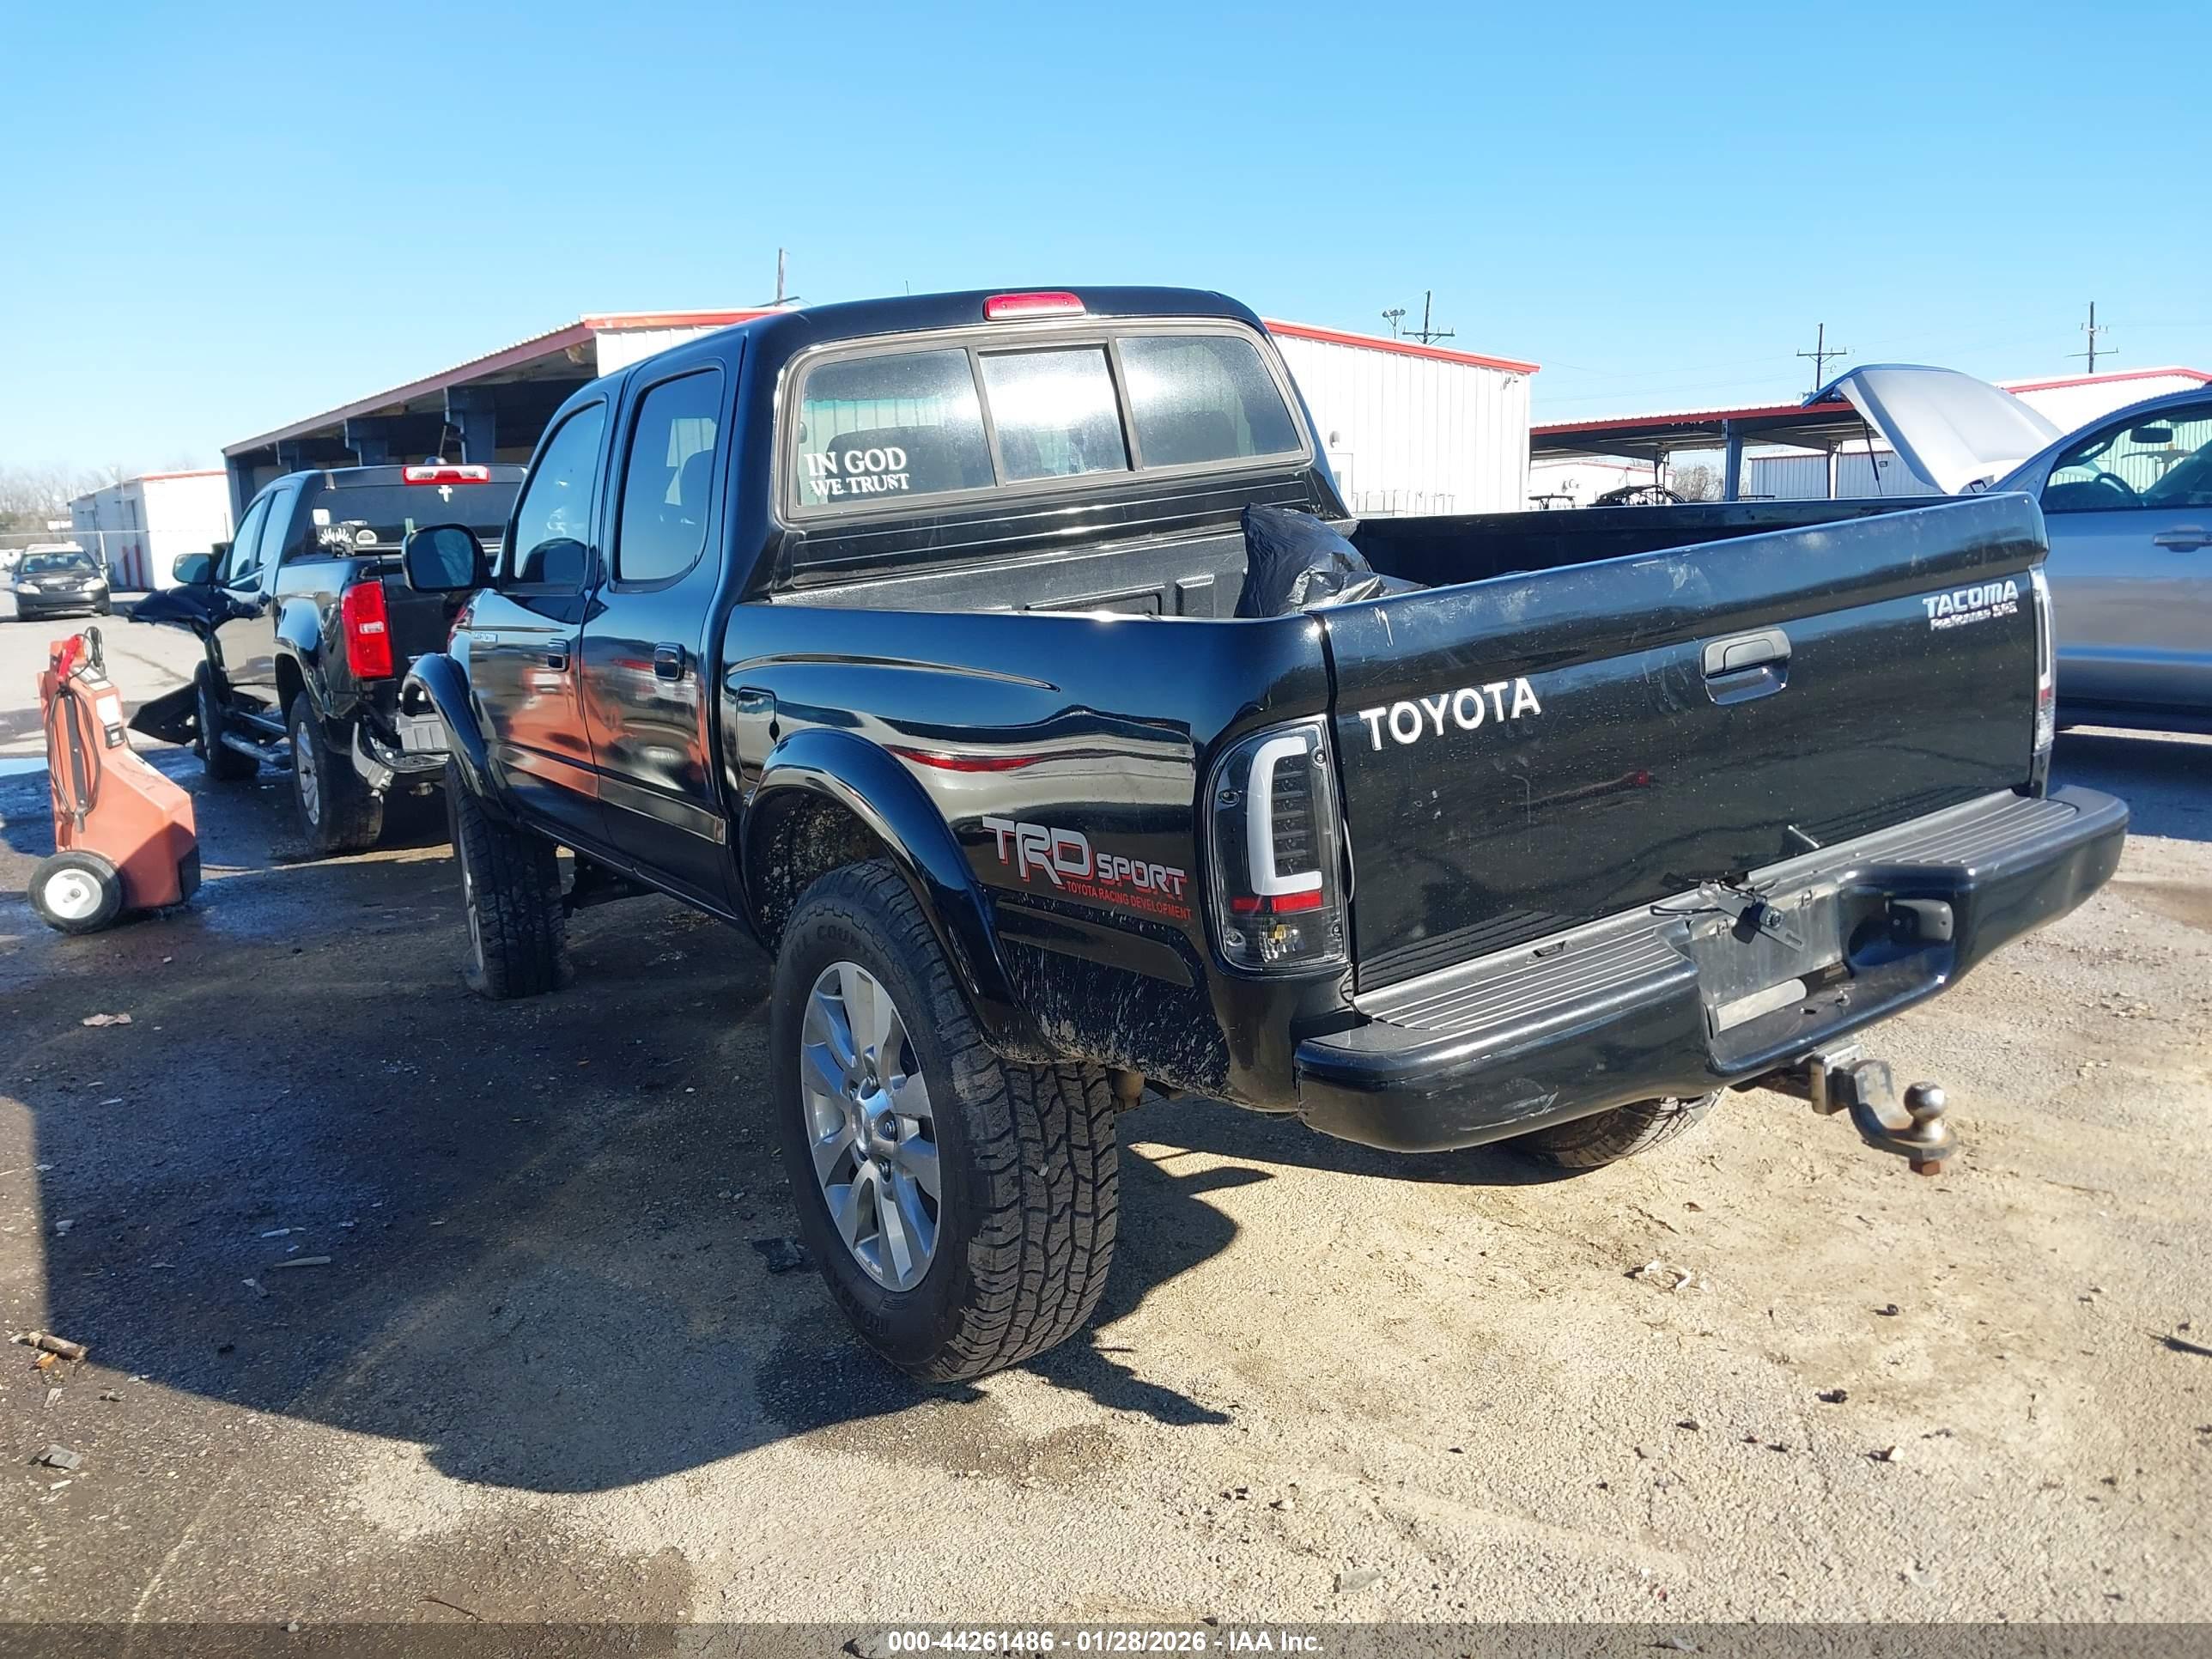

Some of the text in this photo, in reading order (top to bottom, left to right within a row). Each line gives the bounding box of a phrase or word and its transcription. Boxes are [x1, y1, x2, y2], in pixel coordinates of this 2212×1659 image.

[804, 447, 907, 477] IN GOD
[810, 473, 910, 496] WE TRUST
[1922, 580, 2019, 618] TACOMA
[1358, 677, 1542, 751] TOYOTA
[981, 815, 1187, 900] TRD SPORT
[1066, 880, 1192, 921] TOYOTA RACING DEVELOPMENT
